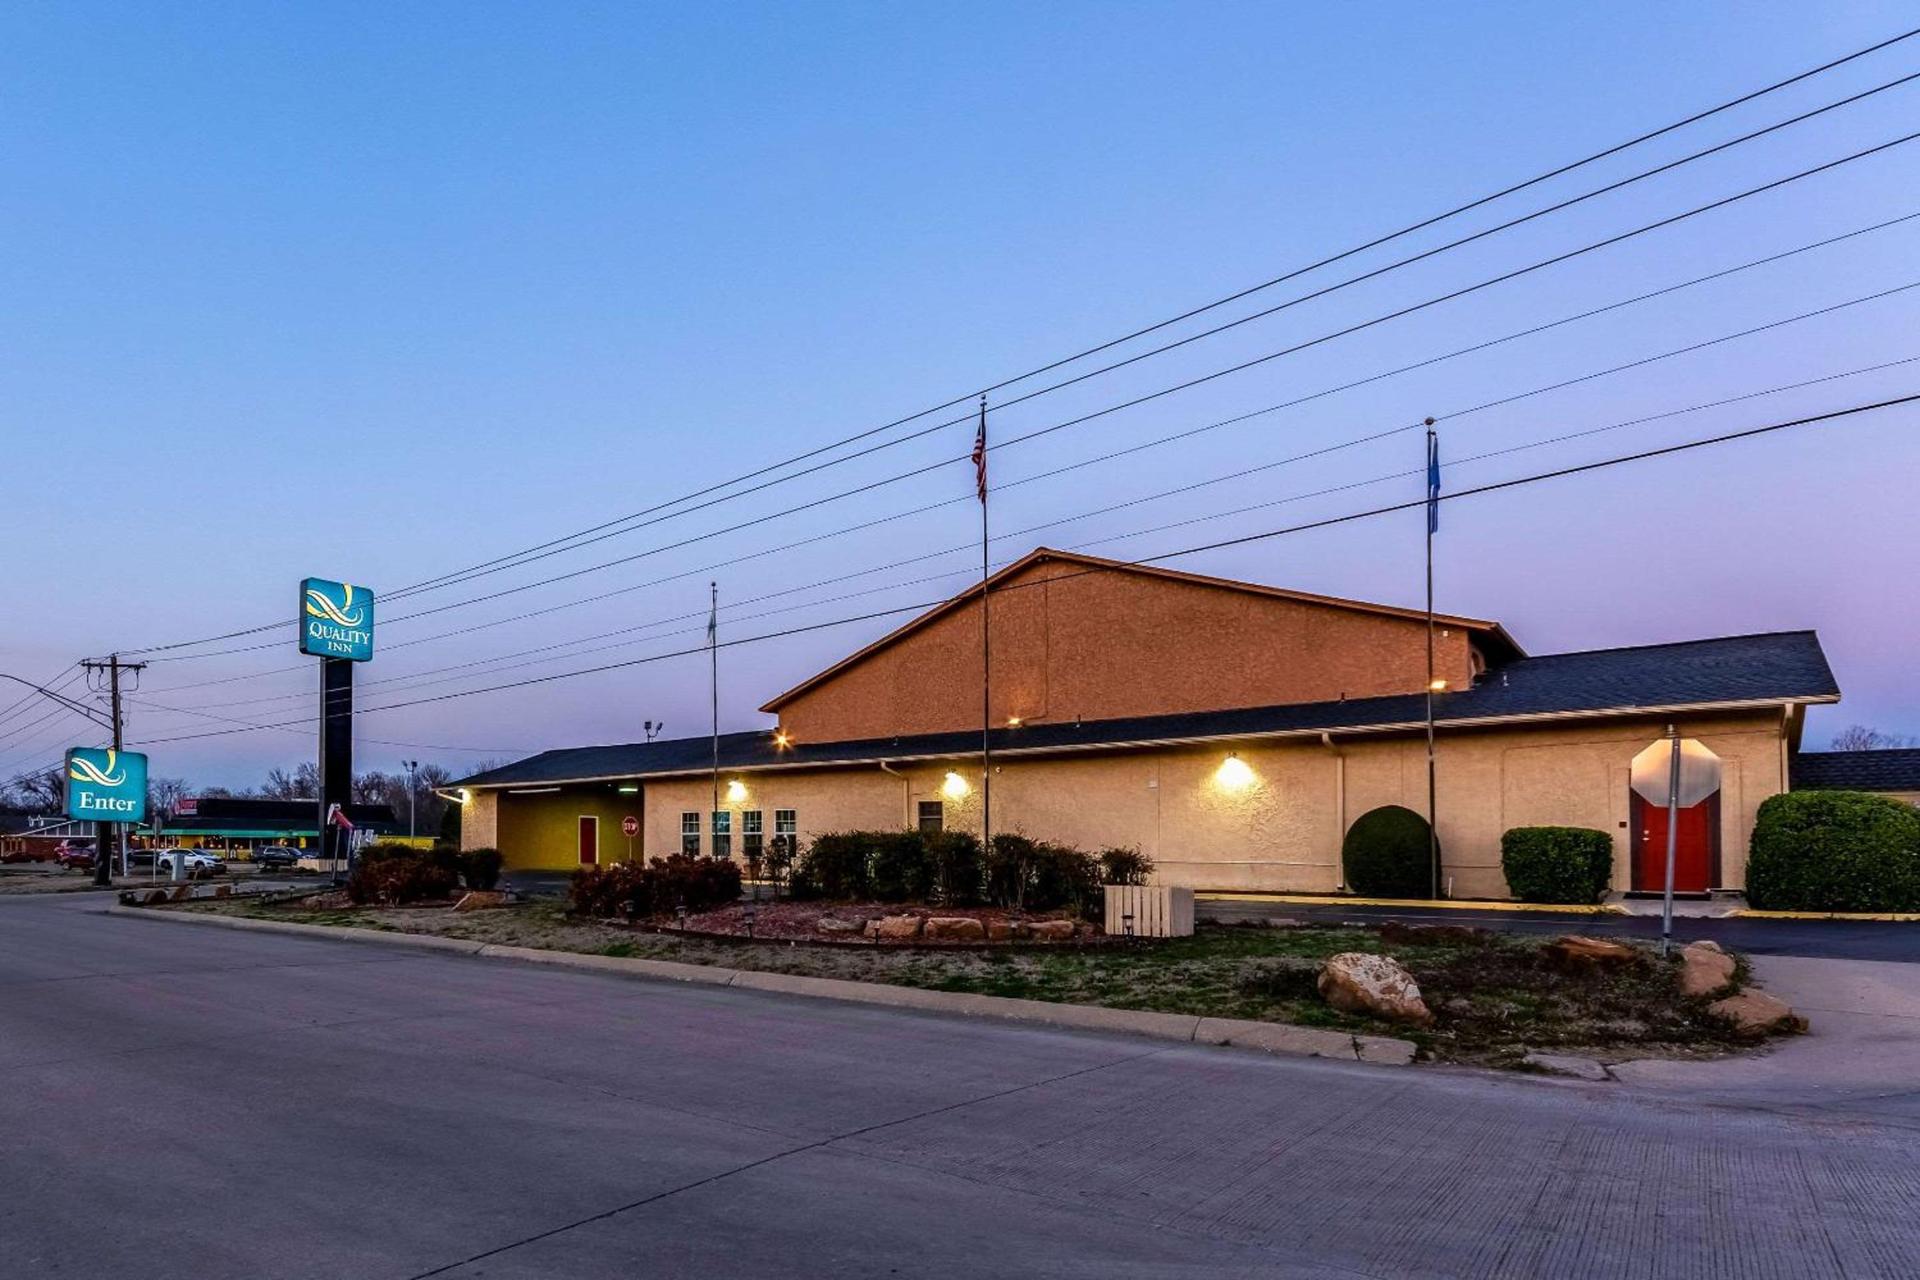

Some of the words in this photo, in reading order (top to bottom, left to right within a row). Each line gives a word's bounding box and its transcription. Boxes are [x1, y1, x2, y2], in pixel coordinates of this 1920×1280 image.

[309, 621, 370, 645] QUALITY
[327, 641, 352, 653] INN
[78, 791, 136, 811] Enter
